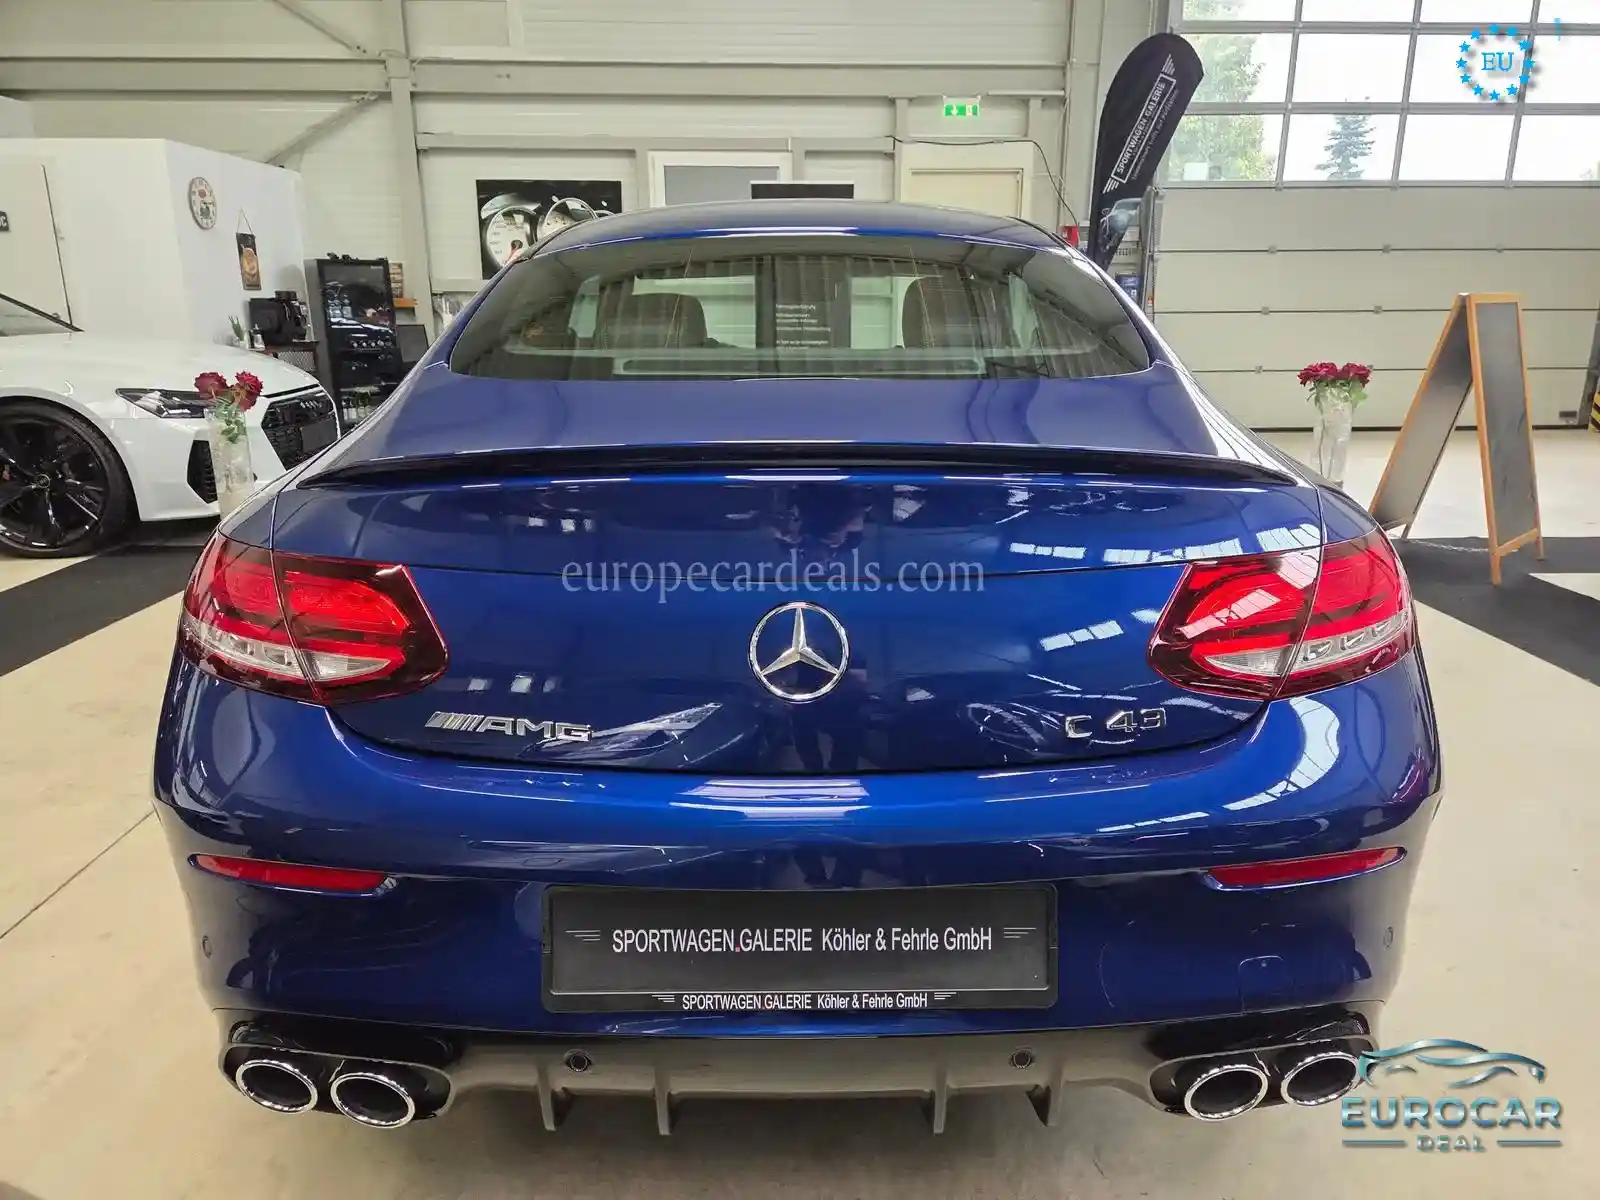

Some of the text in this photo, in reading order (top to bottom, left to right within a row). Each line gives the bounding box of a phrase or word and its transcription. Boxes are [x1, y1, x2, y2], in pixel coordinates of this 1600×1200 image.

[475, 715, 593, 742] AMG
[1064, 709, 1167, 739] C 43
[822, 928, 872, 952] Köhler
[875, 928, 887, 951] &
[891, 928, 939, 951] Fehrle
[943, 926, 992, 951] GmbH
[817, 993, 850, 1009] Köhler
[851, 994, 859, 1008] &
[862, 993, 893, 1009] Fehrle
[896, 992, 928, 1008] GmbH
